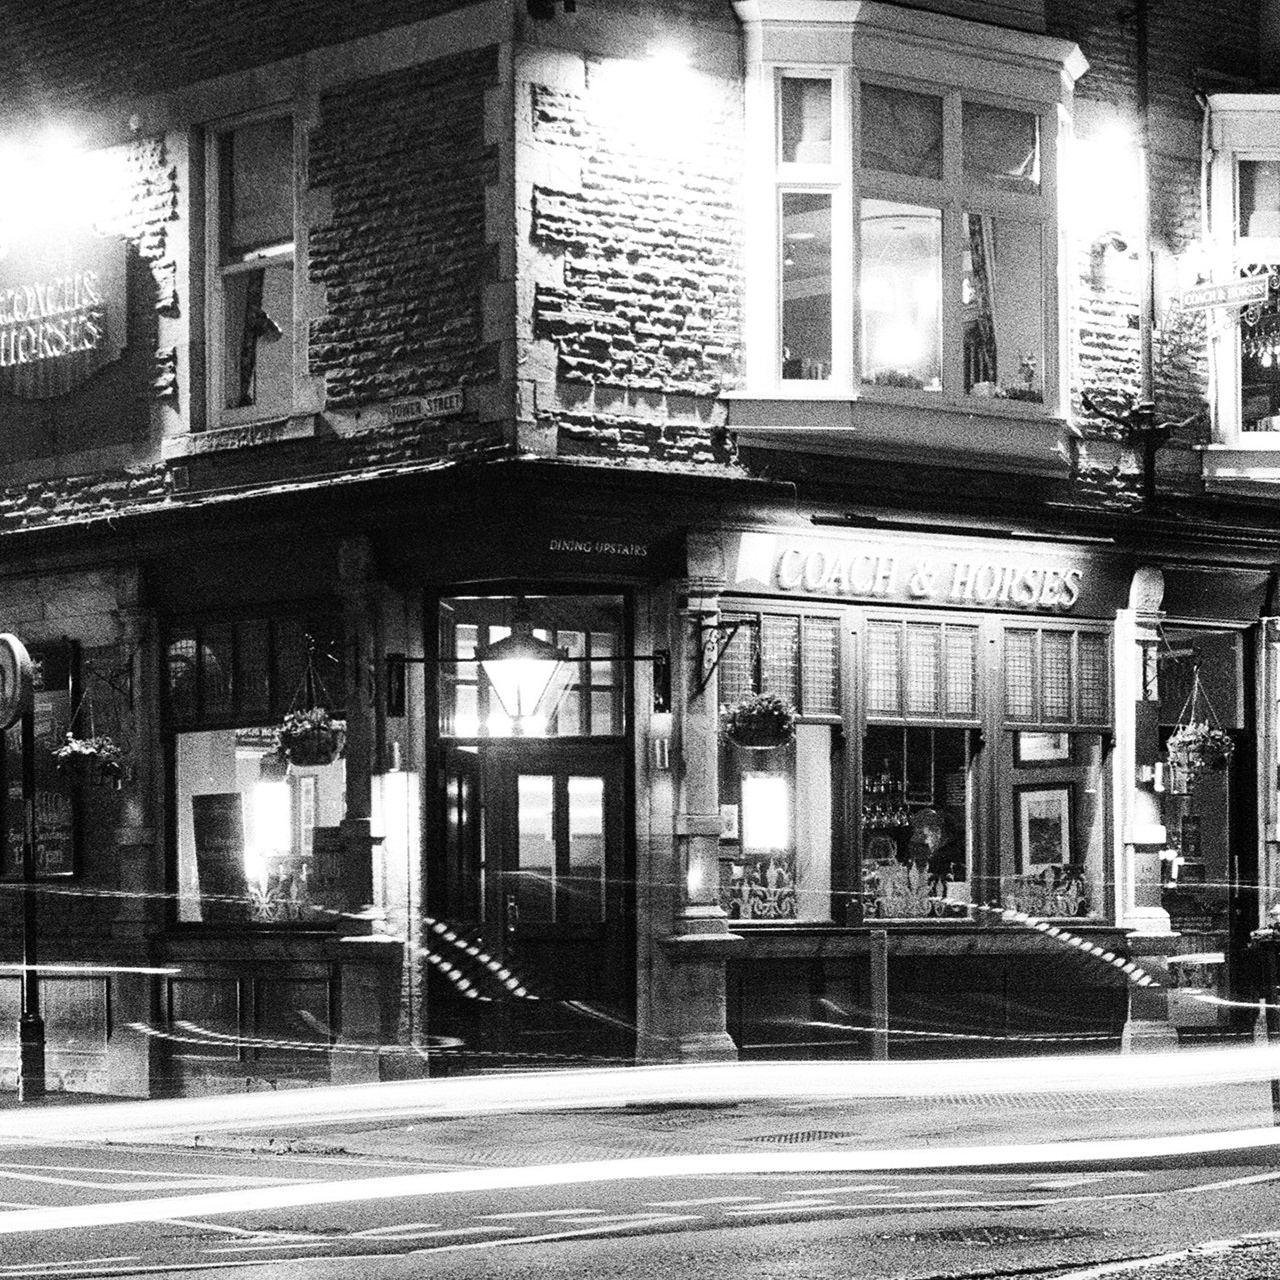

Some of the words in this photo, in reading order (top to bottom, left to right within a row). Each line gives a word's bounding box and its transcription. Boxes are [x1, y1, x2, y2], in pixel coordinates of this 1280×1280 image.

[426, 394, 460, 414] STREET
[549, 538, 592, 553] DINING
[595, 541, 648, 557] UPSTAIRS
[775, 548, 897, 598] COACH
[906, 558, 937, 600] &
[948, 562, 1084, 608] HORSES
